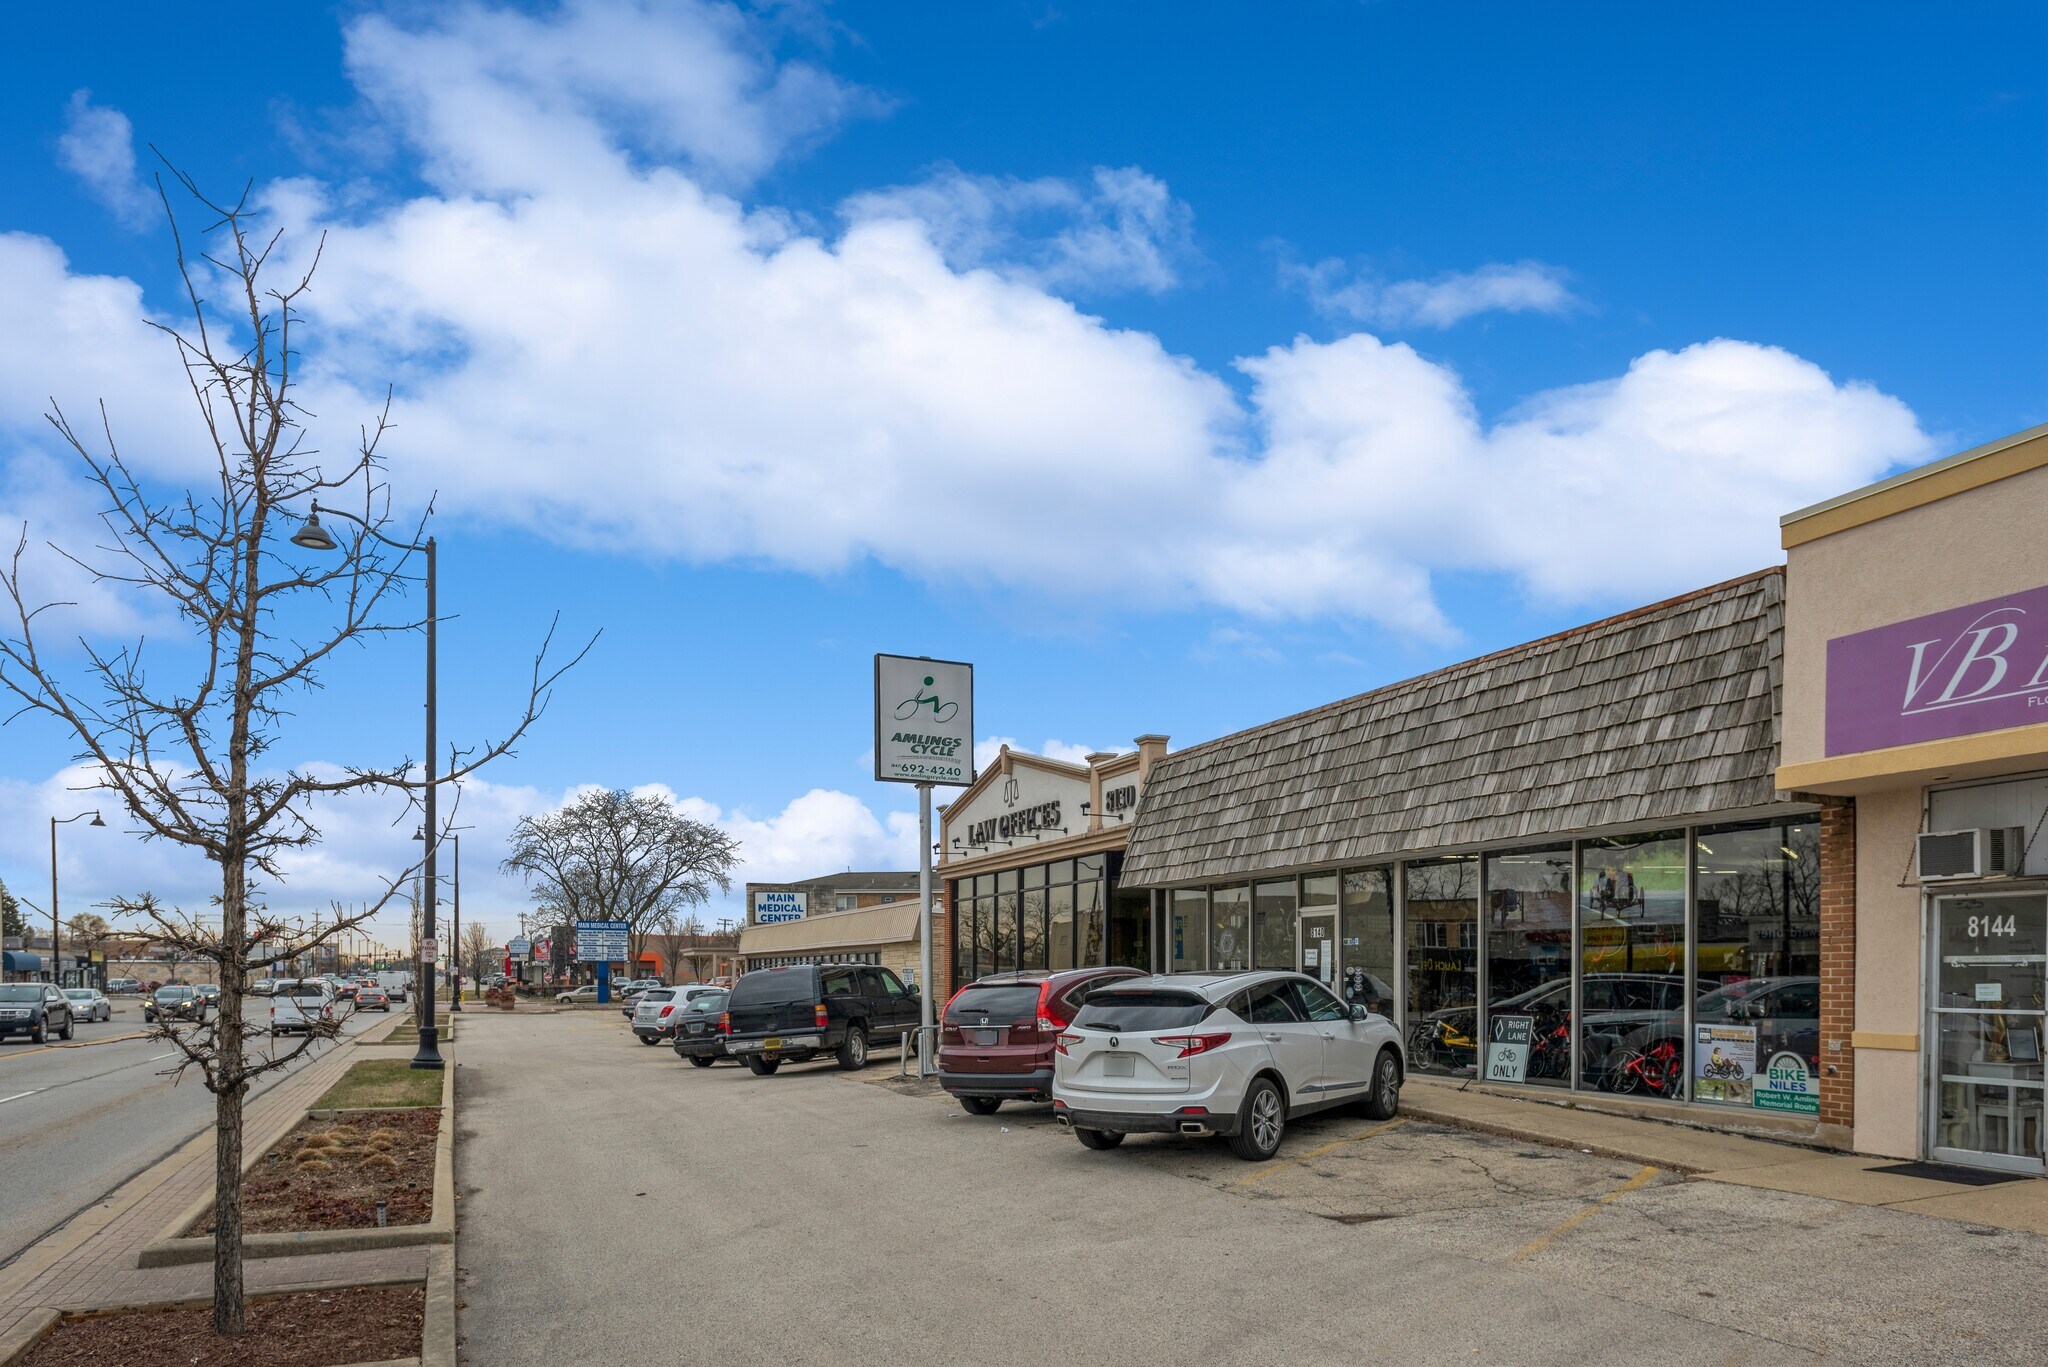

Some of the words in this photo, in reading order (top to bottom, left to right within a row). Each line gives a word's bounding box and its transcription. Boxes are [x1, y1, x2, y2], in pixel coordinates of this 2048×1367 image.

[1903, 607, 2026, 710] VB
[891, 732, 962, 748] AMLINGS
[910, 744, 956, 757] CYCLE
[901, 763, 961, 776] 692-4240
[893, 772, 960, 781] www.amlingscycle.com
[1105, 785, 1136, 812] 8130
[967, 817, 998, 846] LAW
[998, 800, 1061, 838] OFFICES
[767, 894, 795, 902] MAIN
[758, 904, 804, 912] MEDICAL
[1968, 915, 2016, 937] 8144
[1508, 1020, 1530, 1030] RIGHT
[1507, 1032, 1527, 1041] LANE
[1493, 1064, 1518, 1078] ONLY
[1769, 1068, 1806, 1082] BIKE
[1769, 1080, 1807, 1092] NILES
[1756, 1091, 1781, 1100] Robert
[1759, 1099, 1792, 1109] Memorial
[1794, 1102, 1817, 1111] Route
